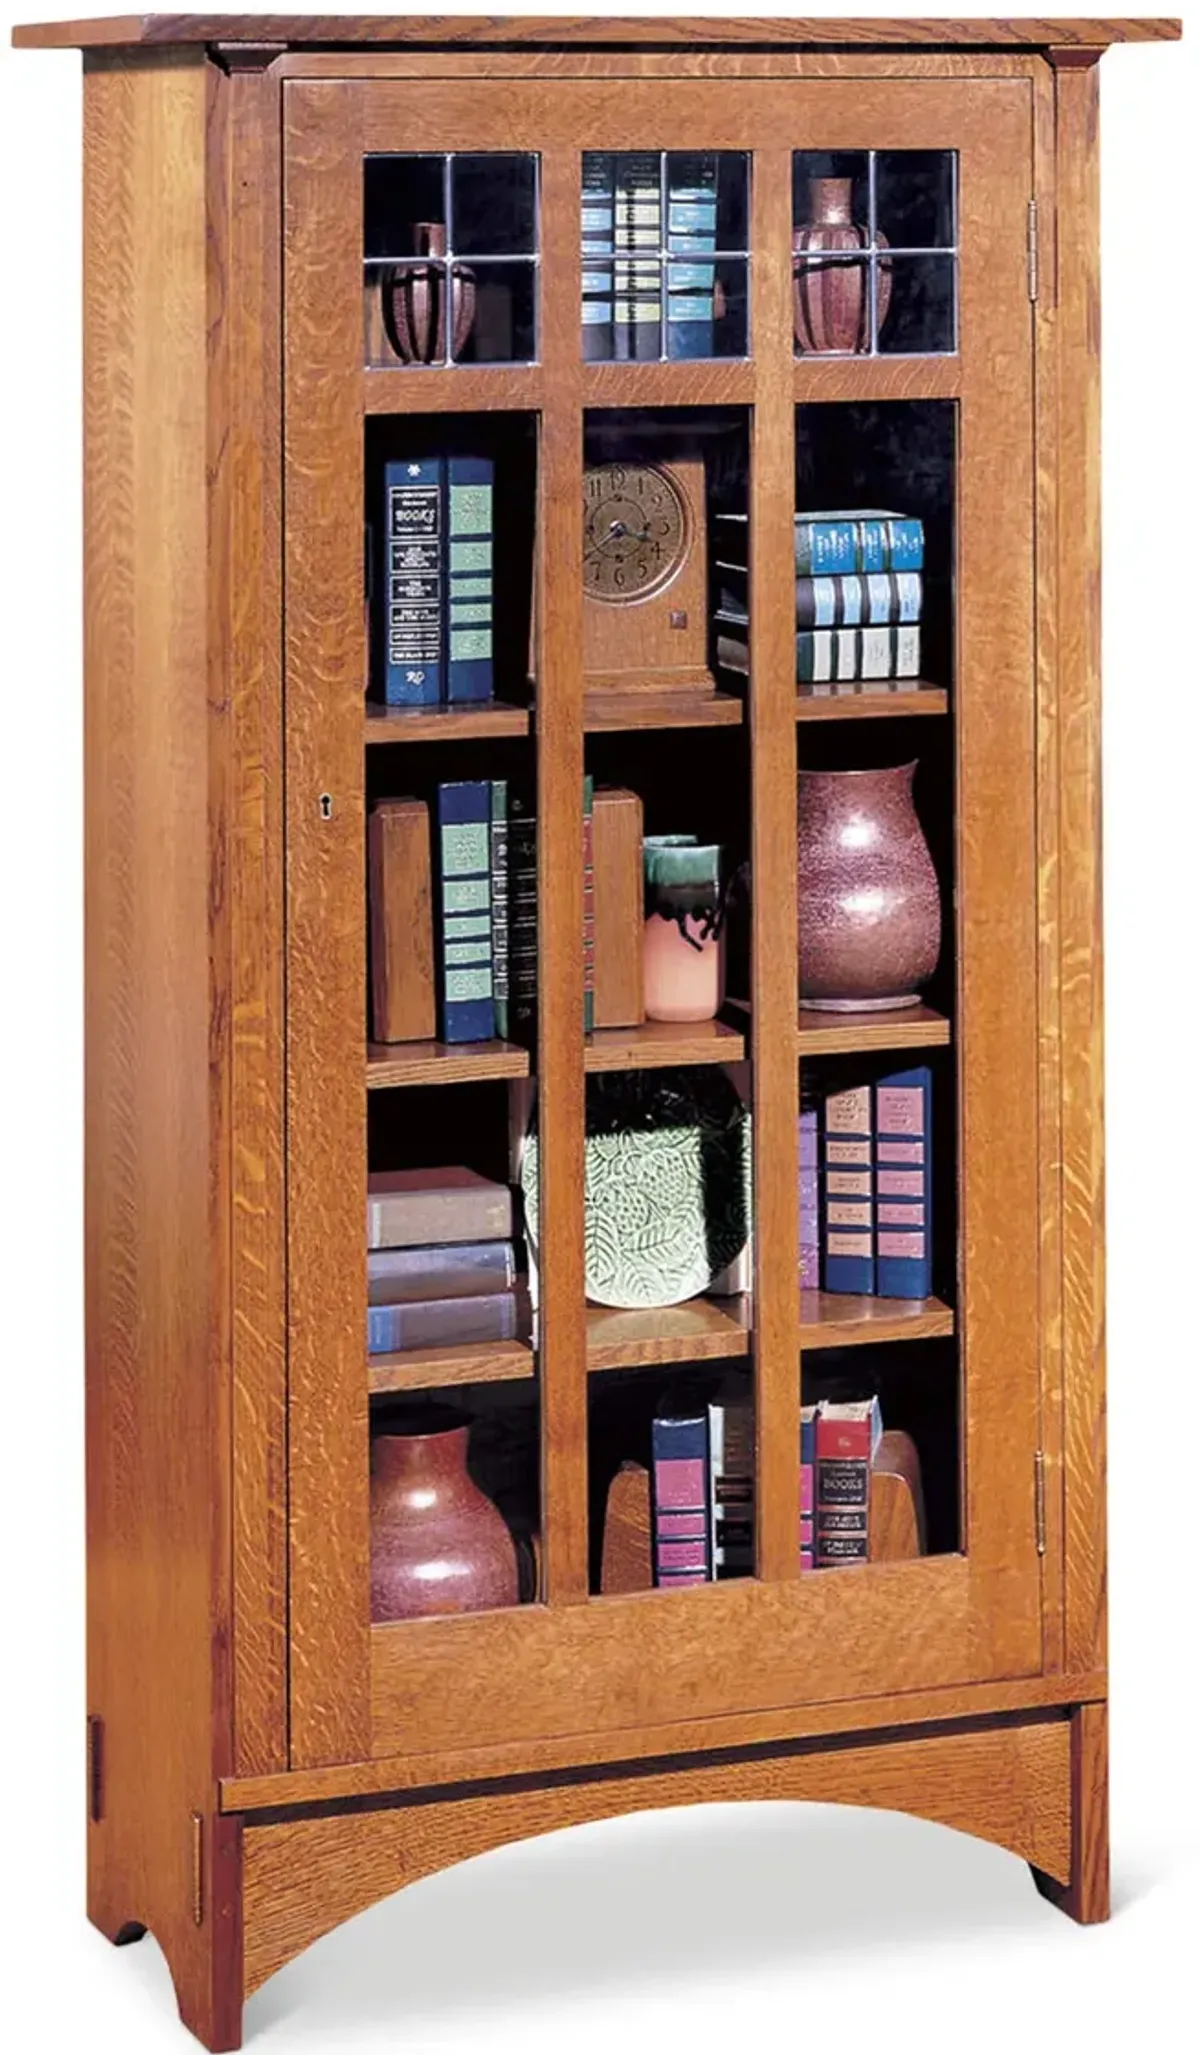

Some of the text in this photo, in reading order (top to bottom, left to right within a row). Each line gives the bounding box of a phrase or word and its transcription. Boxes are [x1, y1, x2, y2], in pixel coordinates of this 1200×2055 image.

[608, 464, 626, 490] 12
[638, 475, 645, 495] 1
[590, 478, 602, 496] 11
[651, 494, 663, 512] 2
[395, 509, 436, 527] BOOKS
[659, 521, 671, 536] 3
[650, 541, 667, 560] 4
[589, 560, 601, 580] 7
[613, 567, 625, 586] 6
[637, 558, 648, 579] 5
[823, 1478, 863, 1489] BOOKS
